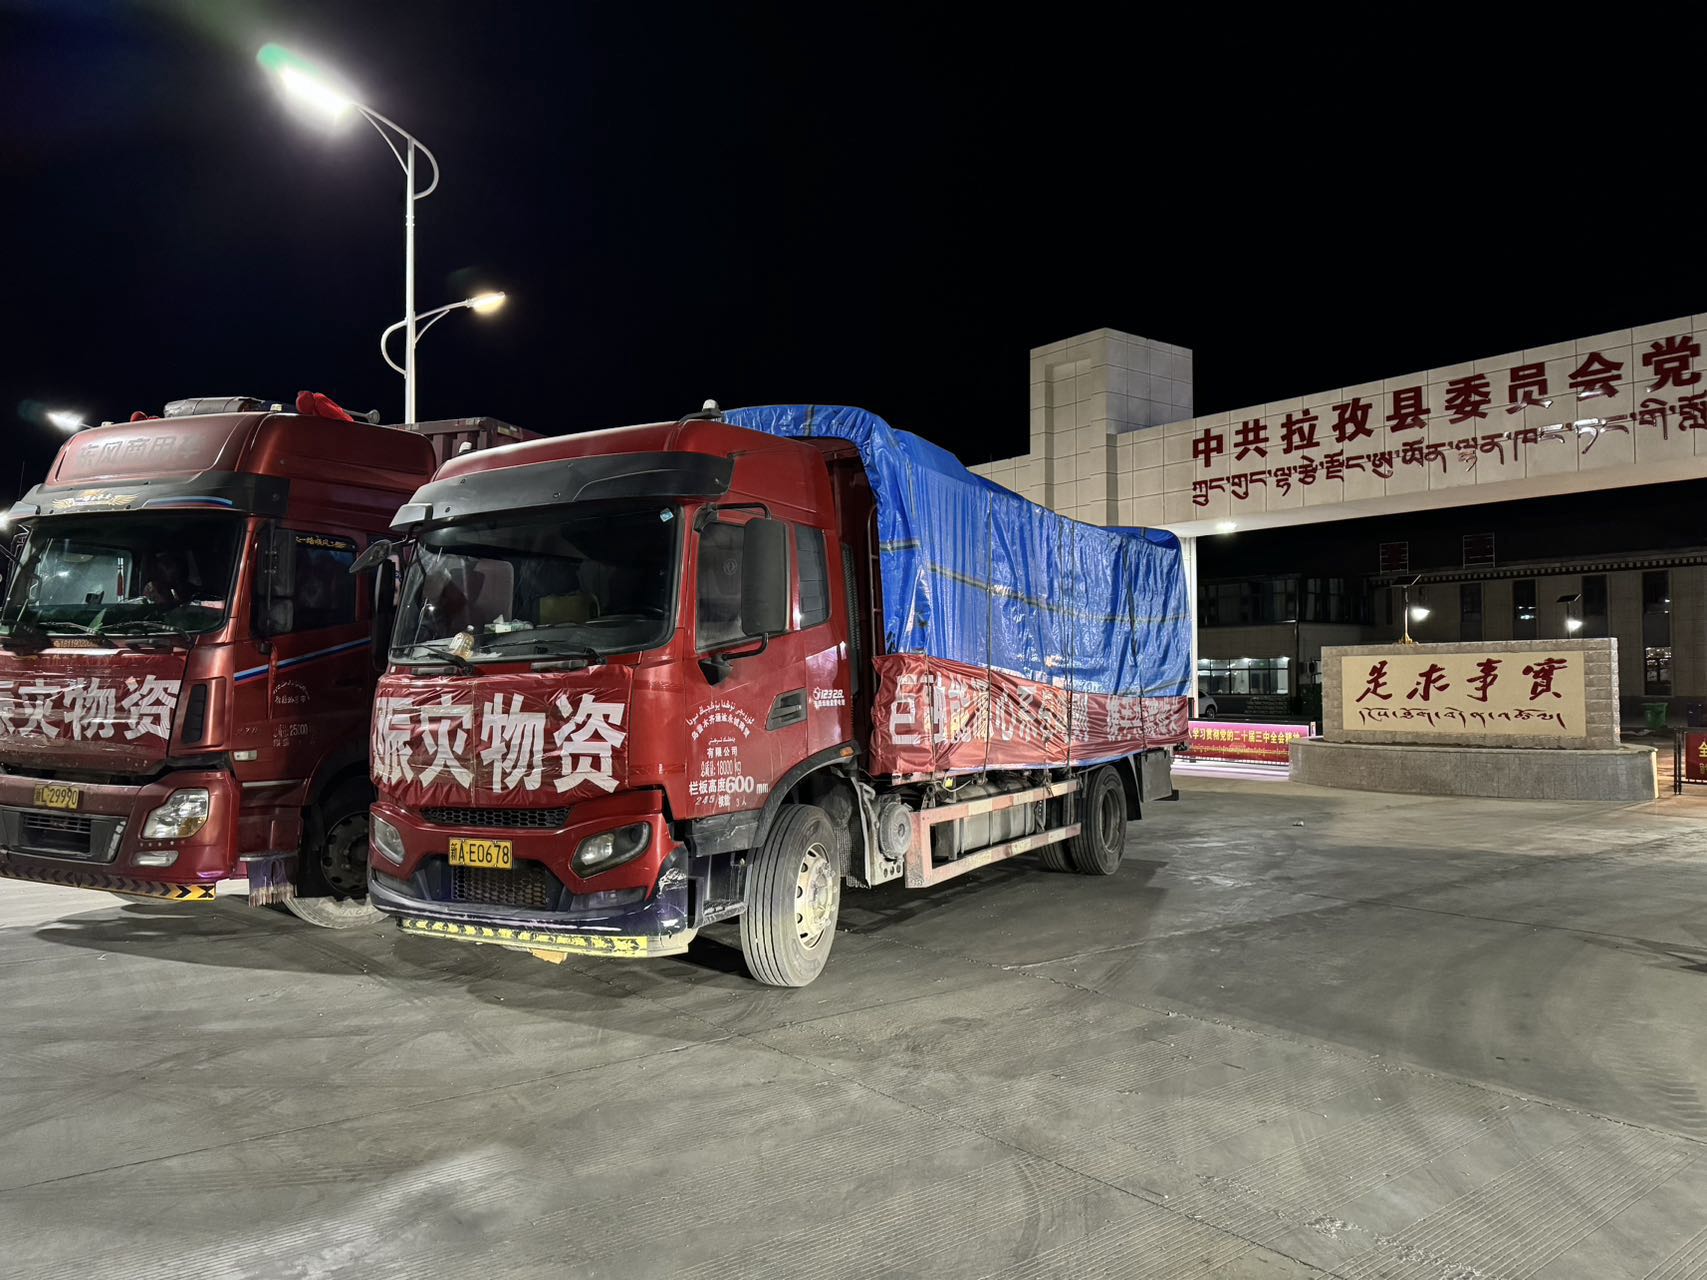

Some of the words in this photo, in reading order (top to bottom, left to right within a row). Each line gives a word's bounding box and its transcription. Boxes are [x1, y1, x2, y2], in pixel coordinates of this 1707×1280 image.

[1192, 335, 1703, 469] 中共拉孜县委员会党
[373, 693, 627, 794] 赈灾物资
[707, 746, 738, 759] 有限公司
